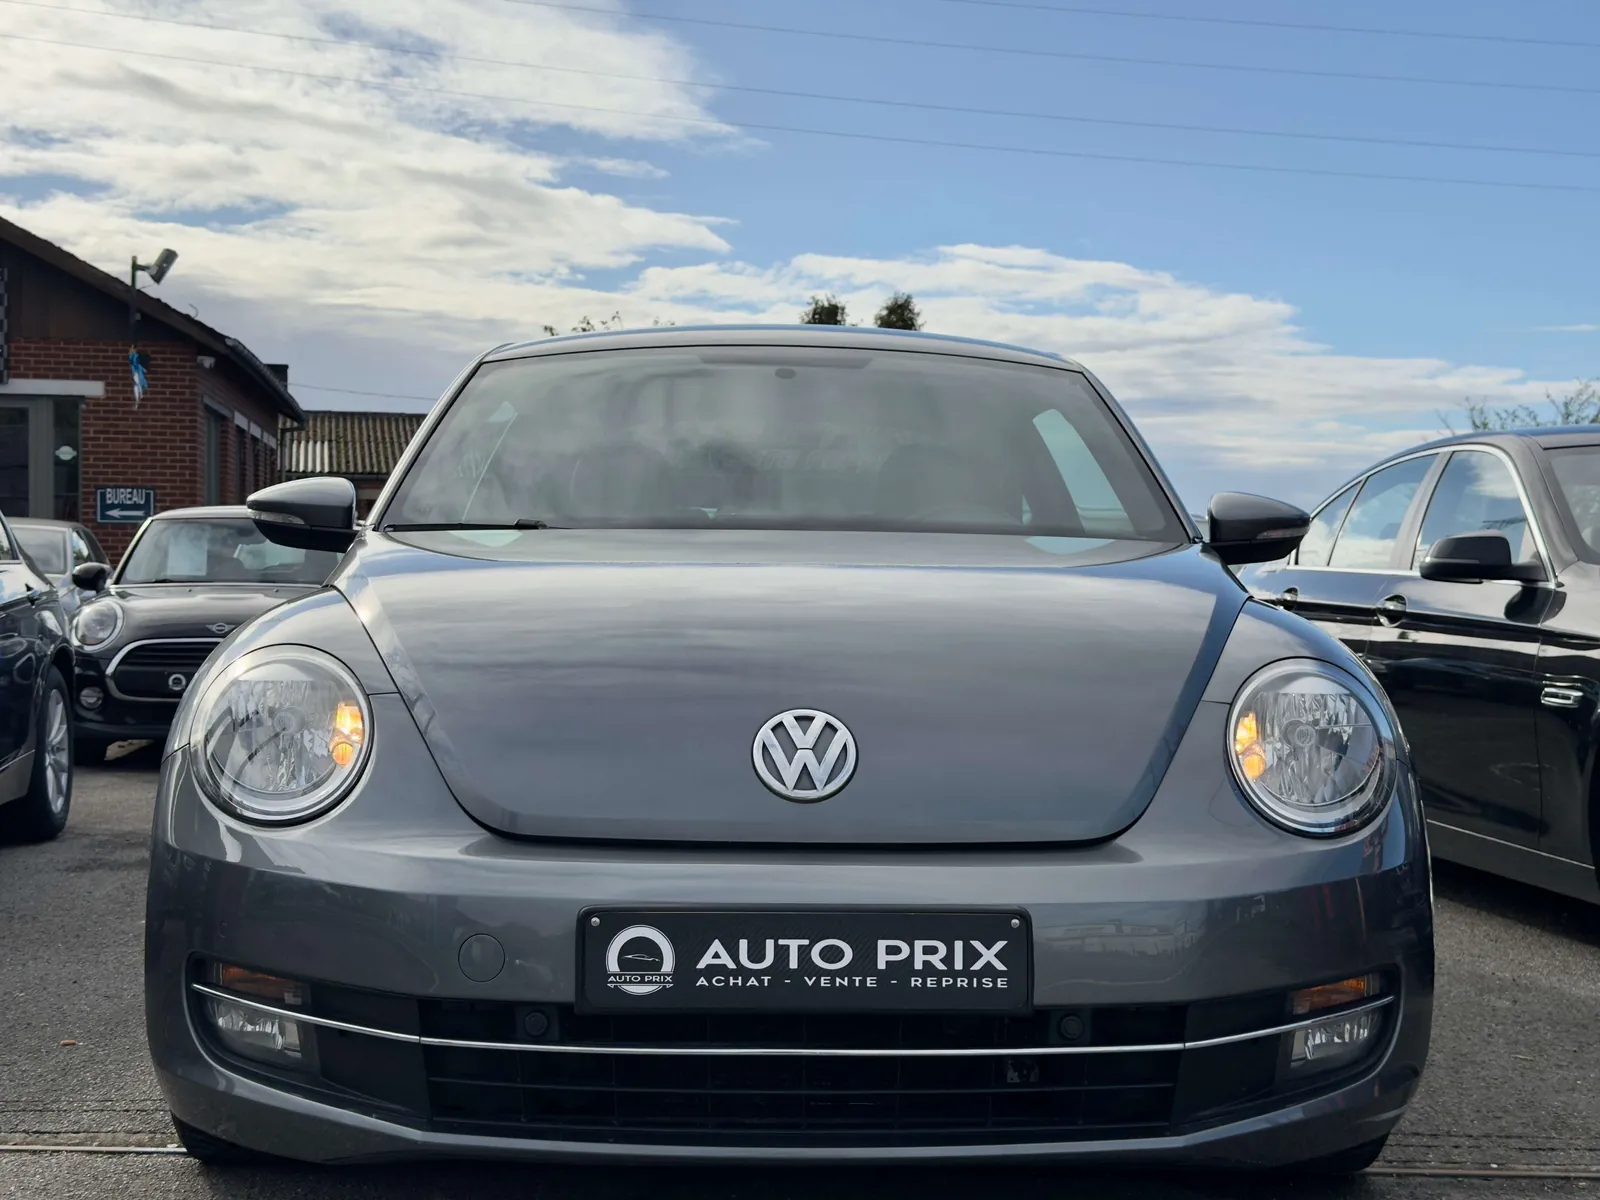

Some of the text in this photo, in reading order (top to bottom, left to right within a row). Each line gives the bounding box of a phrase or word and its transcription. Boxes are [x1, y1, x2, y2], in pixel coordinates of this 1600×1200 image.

[106, 488, 146, 504] BUREAU
[695, 938, 1009, 971] AUTO PRIX
[695, 975, 772, 987] ACHAT
[803, 976, 878, 988] VENTE
[910, 976, 1008, 989] REPRISE
